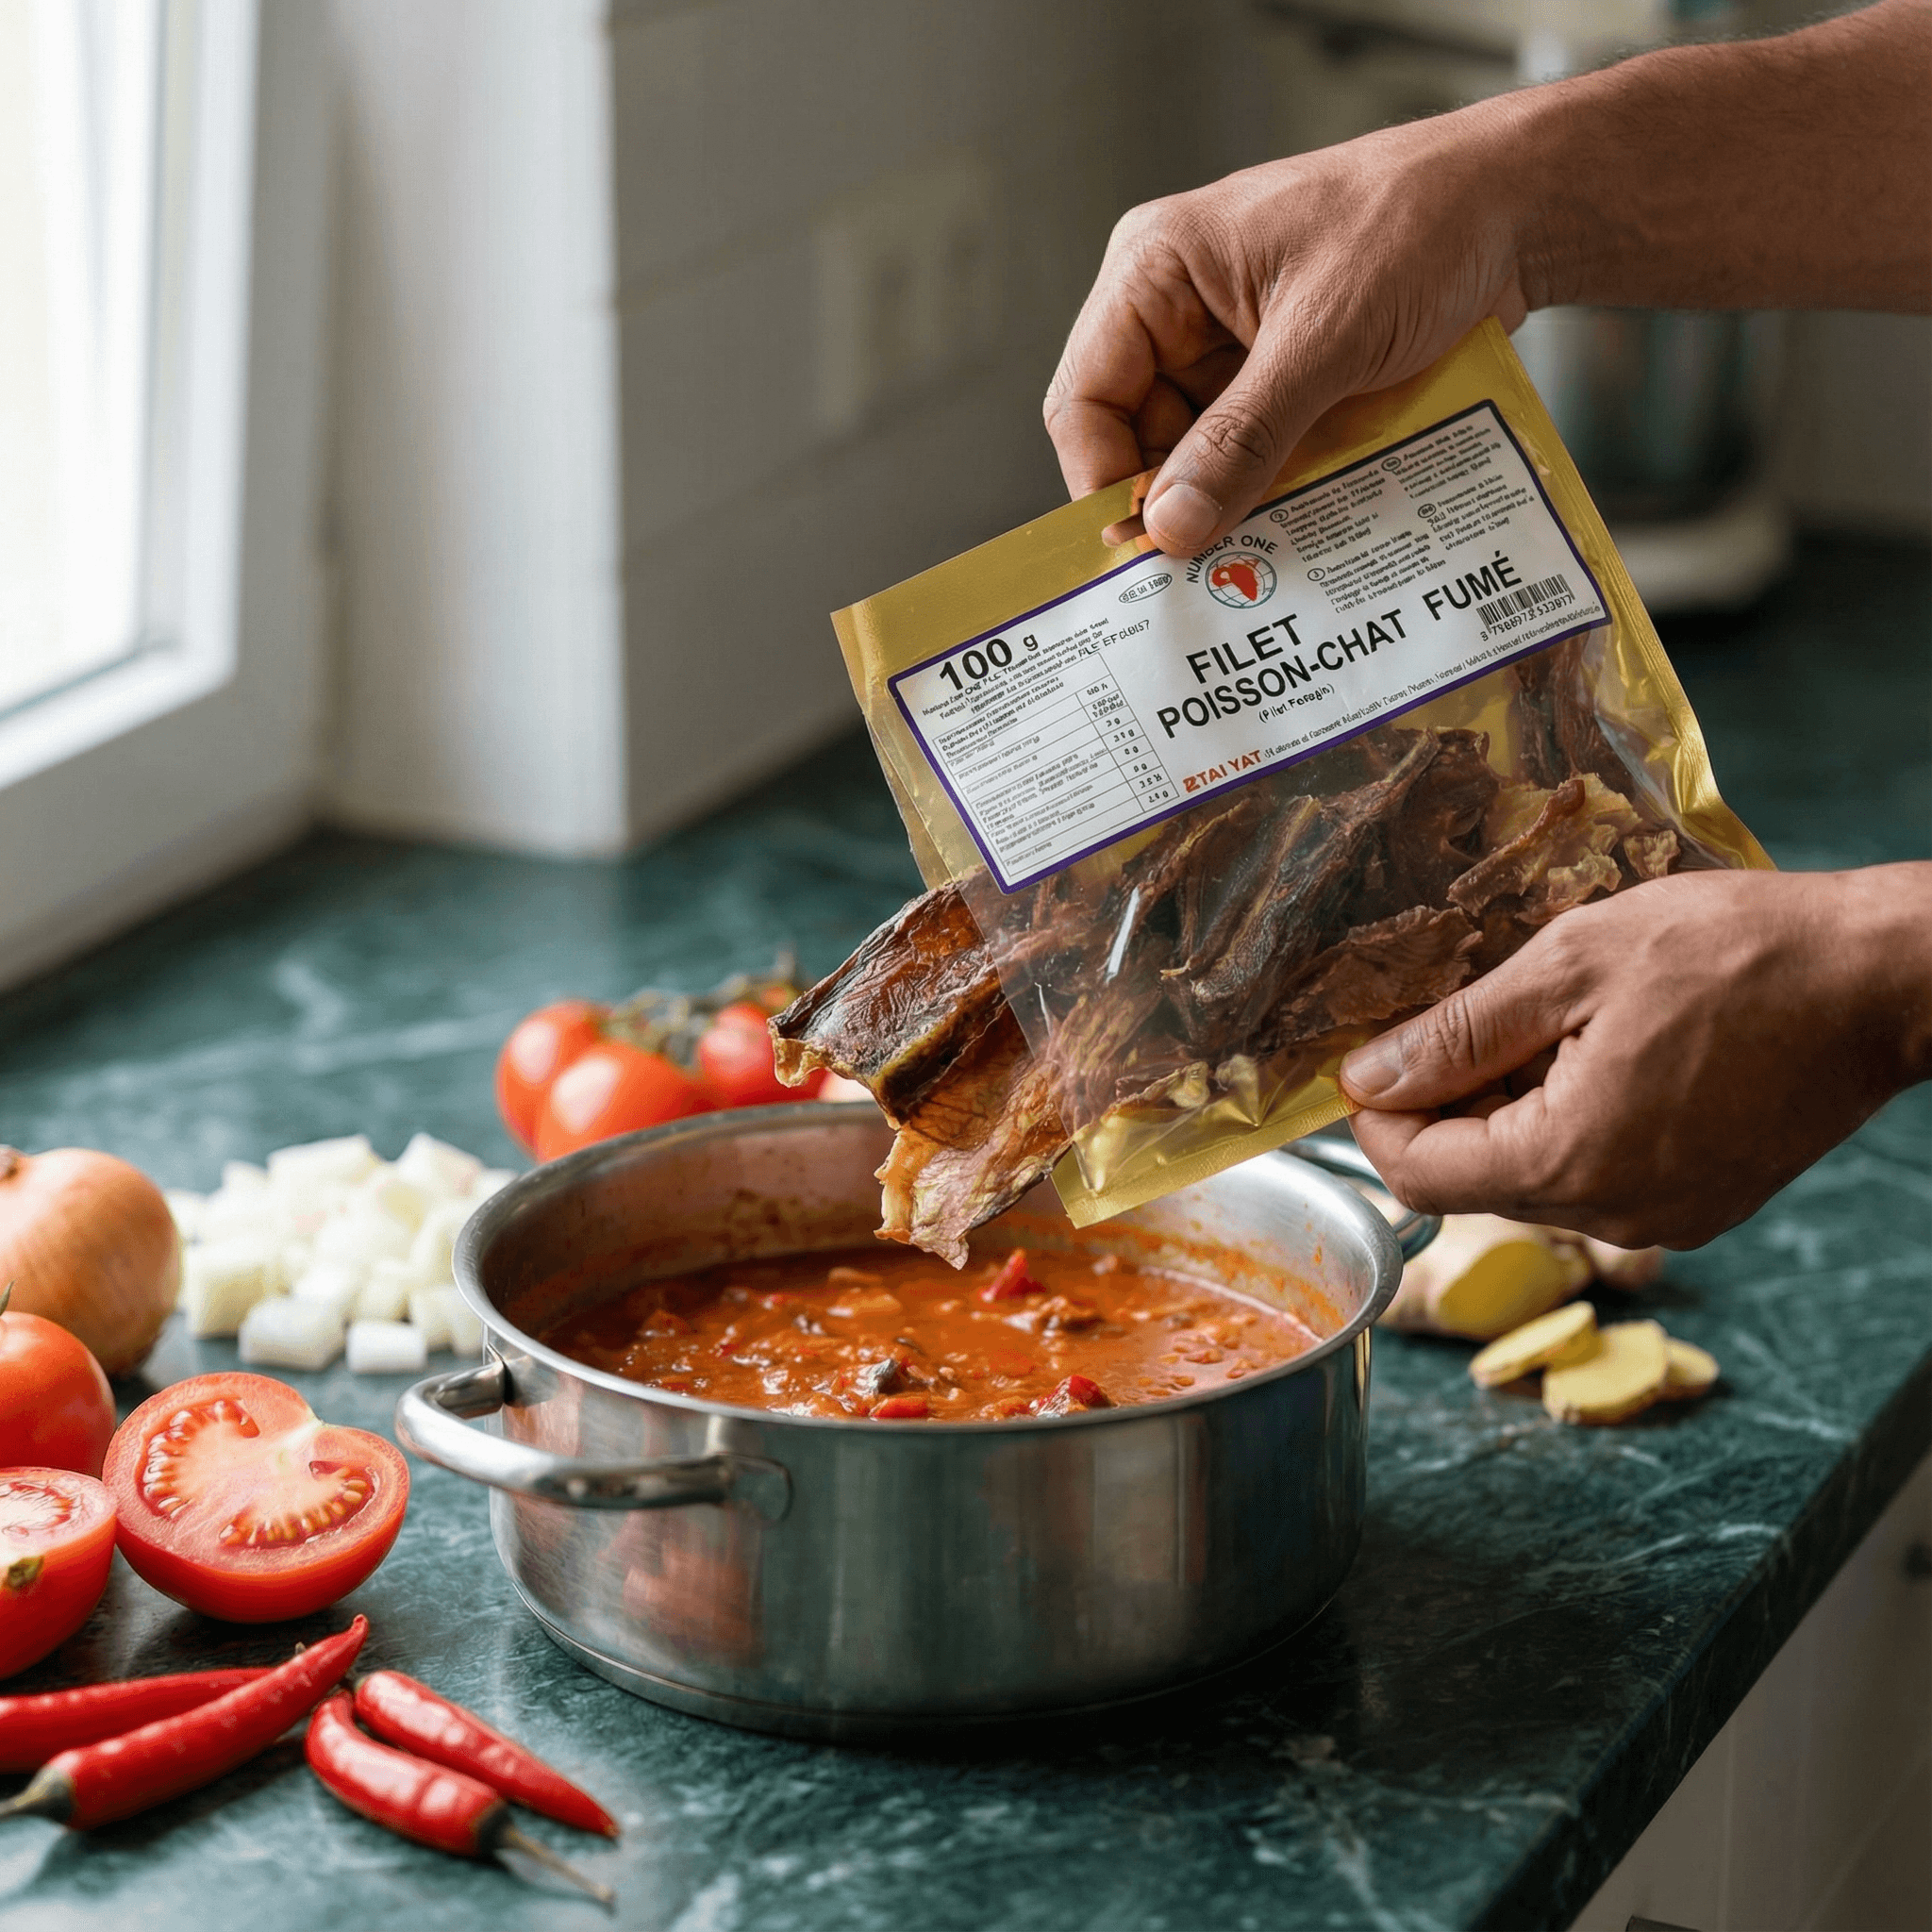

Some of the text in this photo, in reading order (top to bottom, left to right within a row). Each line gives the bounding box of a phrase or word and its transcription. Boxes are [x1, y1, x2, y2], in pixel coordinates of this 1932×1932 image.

[1187, 535, 1278, 584] NUMBER ONE
[940, 634, 1039, 691] 100 g
[1157, 608, 1406, 739] POISSON-CHAT
[1423, 550, 1522, 621] FUMÉ
[1186, 614, 1301, 684] FILET
[1227, 750, 1261, 772] YAT
